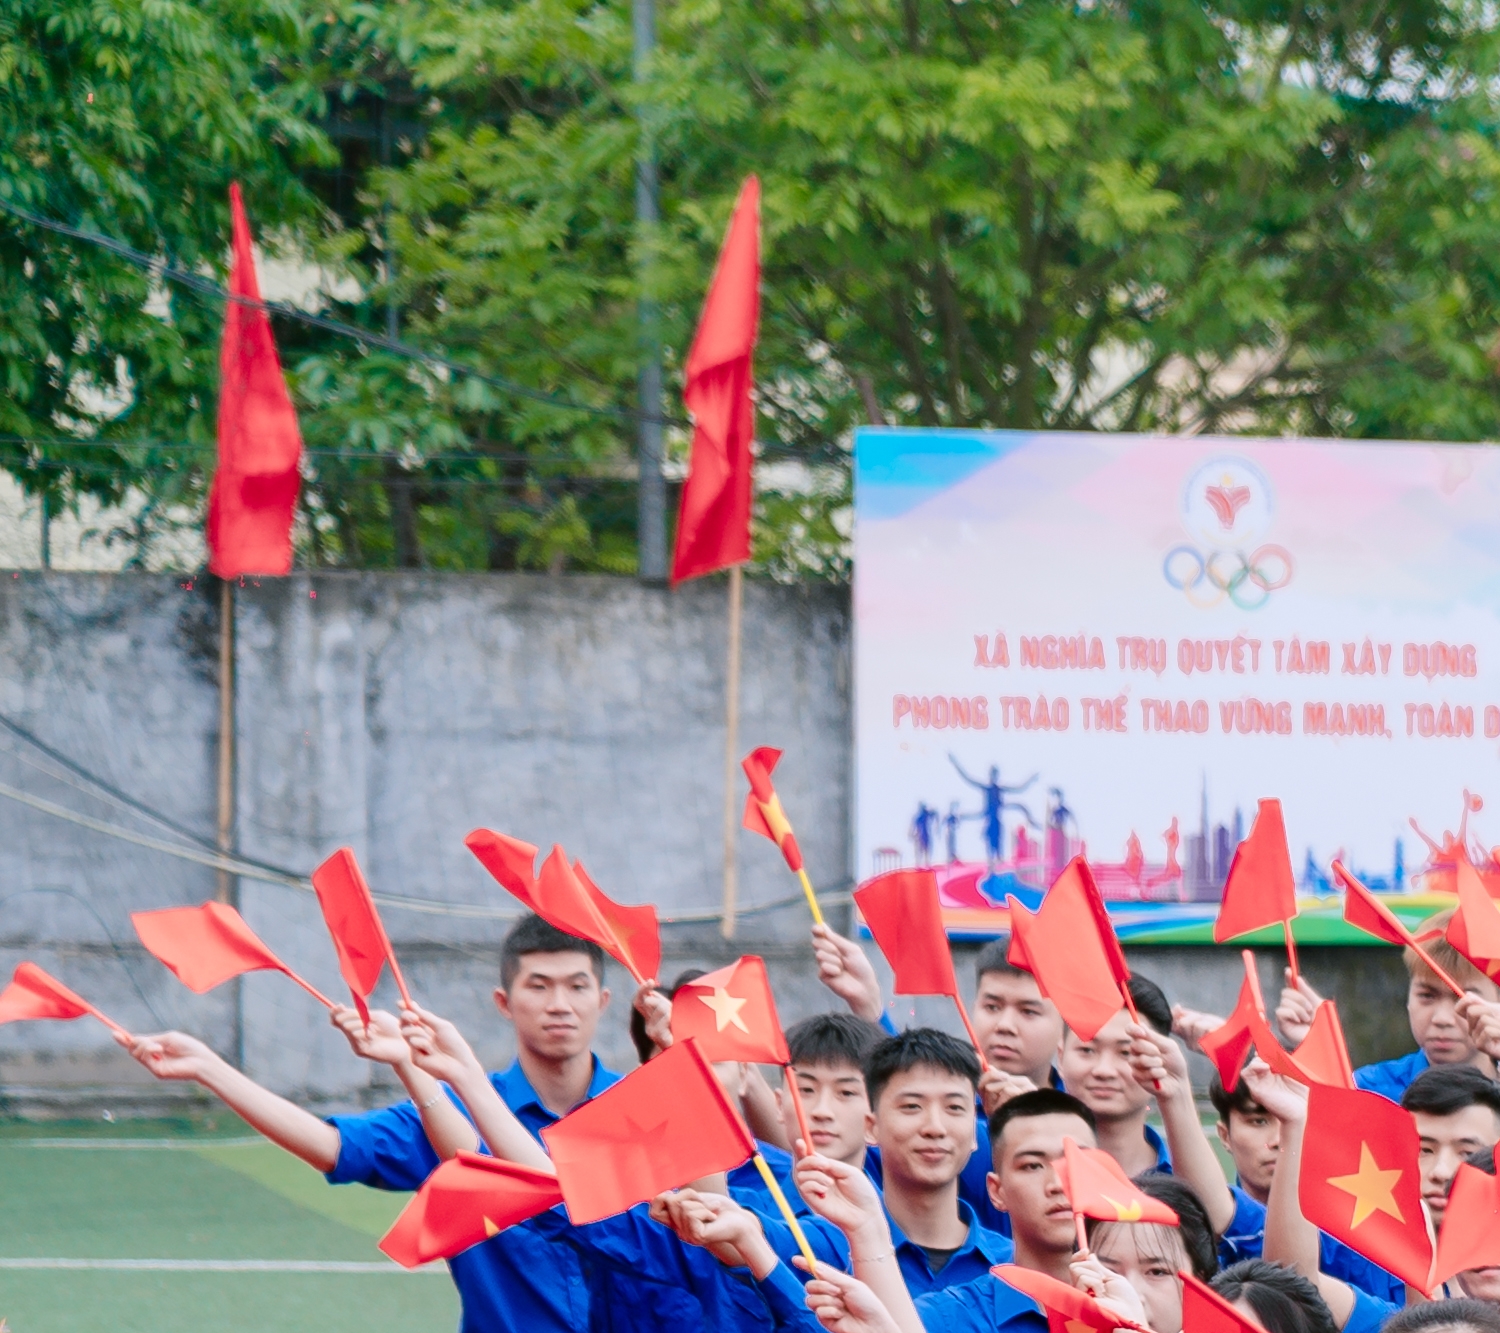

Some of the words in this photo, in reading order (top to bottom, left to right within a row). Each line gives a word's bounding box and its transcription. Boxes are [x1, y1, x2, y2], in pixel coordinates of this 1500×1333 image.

[972, 629, 1011, 669] XÃ
[1019, 630, 1106, 671] NGHĨA
[1115, 635, 1168, 679] TRỤ
[1176, 630, 1262, 677] QUYẾT
[1272, 635, 1331, 675] TÂM
[1341, 635, 1393, 675] XÂY
[1402, 640, 1478, 683] DỰNG
[892, 693, 990, 730] PHONG
[998, 690, 1070, 732] TRÀO
[1080, 685, 1131, 733] THỂ
[1140, 697, 1210, 734] THAO
[1219, 694, 1292, 735] VỮNG
[1404, 700, 1475, 738] TOÀN
